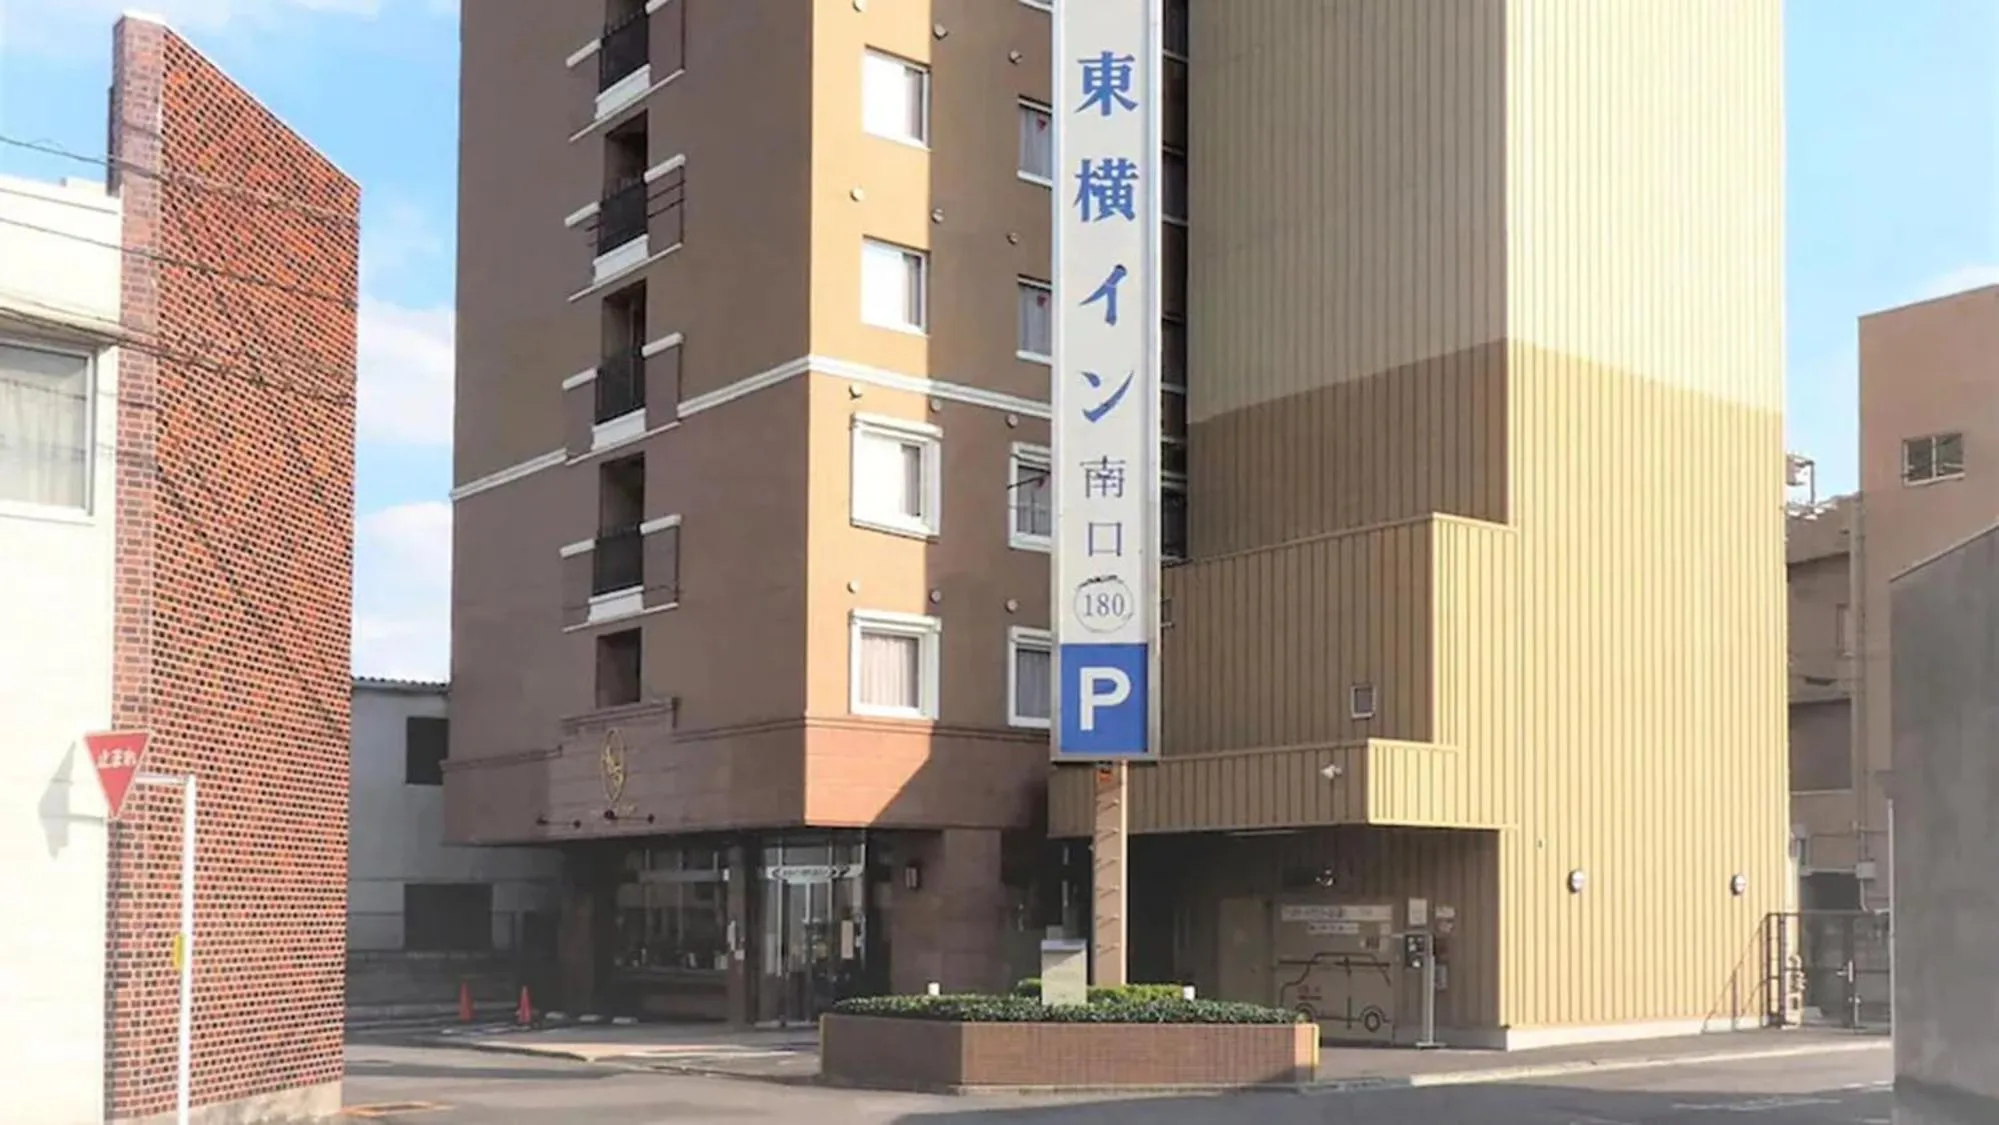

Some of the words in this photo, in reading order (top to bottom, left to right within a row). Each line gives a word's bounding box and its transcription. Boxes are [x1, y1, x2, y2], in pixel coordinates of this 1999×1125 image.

[1073, 51, 1138, 423] 東横イン
[1083, 592, 1125, 617] 180
[1079, 666, 1131, 731] P
[98, 747, 137, 769] 止まれ
